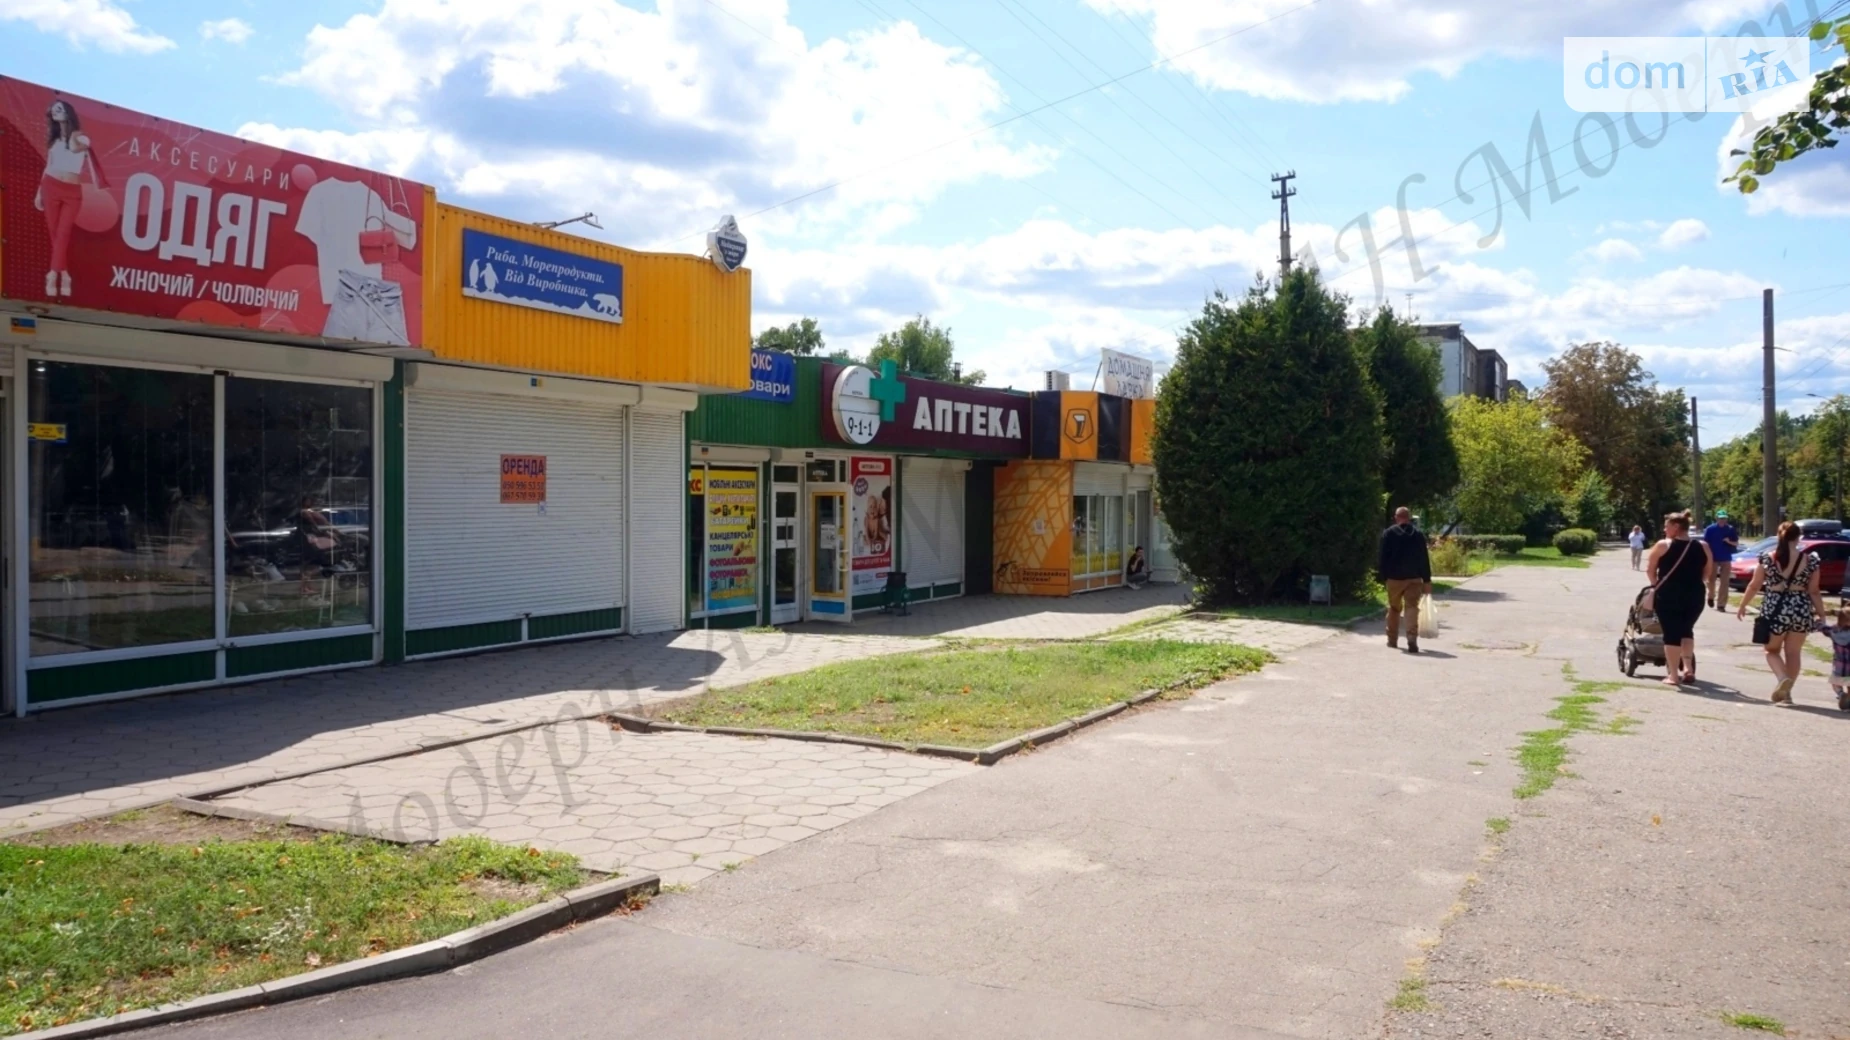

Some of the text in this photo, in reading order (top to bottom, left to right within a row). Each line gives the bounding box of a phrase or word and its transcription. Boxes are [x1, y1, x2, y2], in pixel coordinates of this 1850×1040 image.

[128, 137, 290, 191] АКСЕСУАРИ
[120, 172, 288, 271] ОДЯГ
[486, 246, 605, 284] Риба. Морепродукти.
[110, 265, 194, 298] ЖІНОЧИЙ
[211, 282, 300, 312] ЧОЛОВІЧИЙ
[504, 268, 589, 298] Від Виробника.
[751, 352, 772, 372] ОКС
[748, 379, 791, 397] овари
[848, 416, 873, 437] 9-1-1
[912, 396, 1022, 440] АПТЕКА
[502, 458, 545, 478] ОРЕНДА
[709, 544, 733, 552] ТОВАРИ
